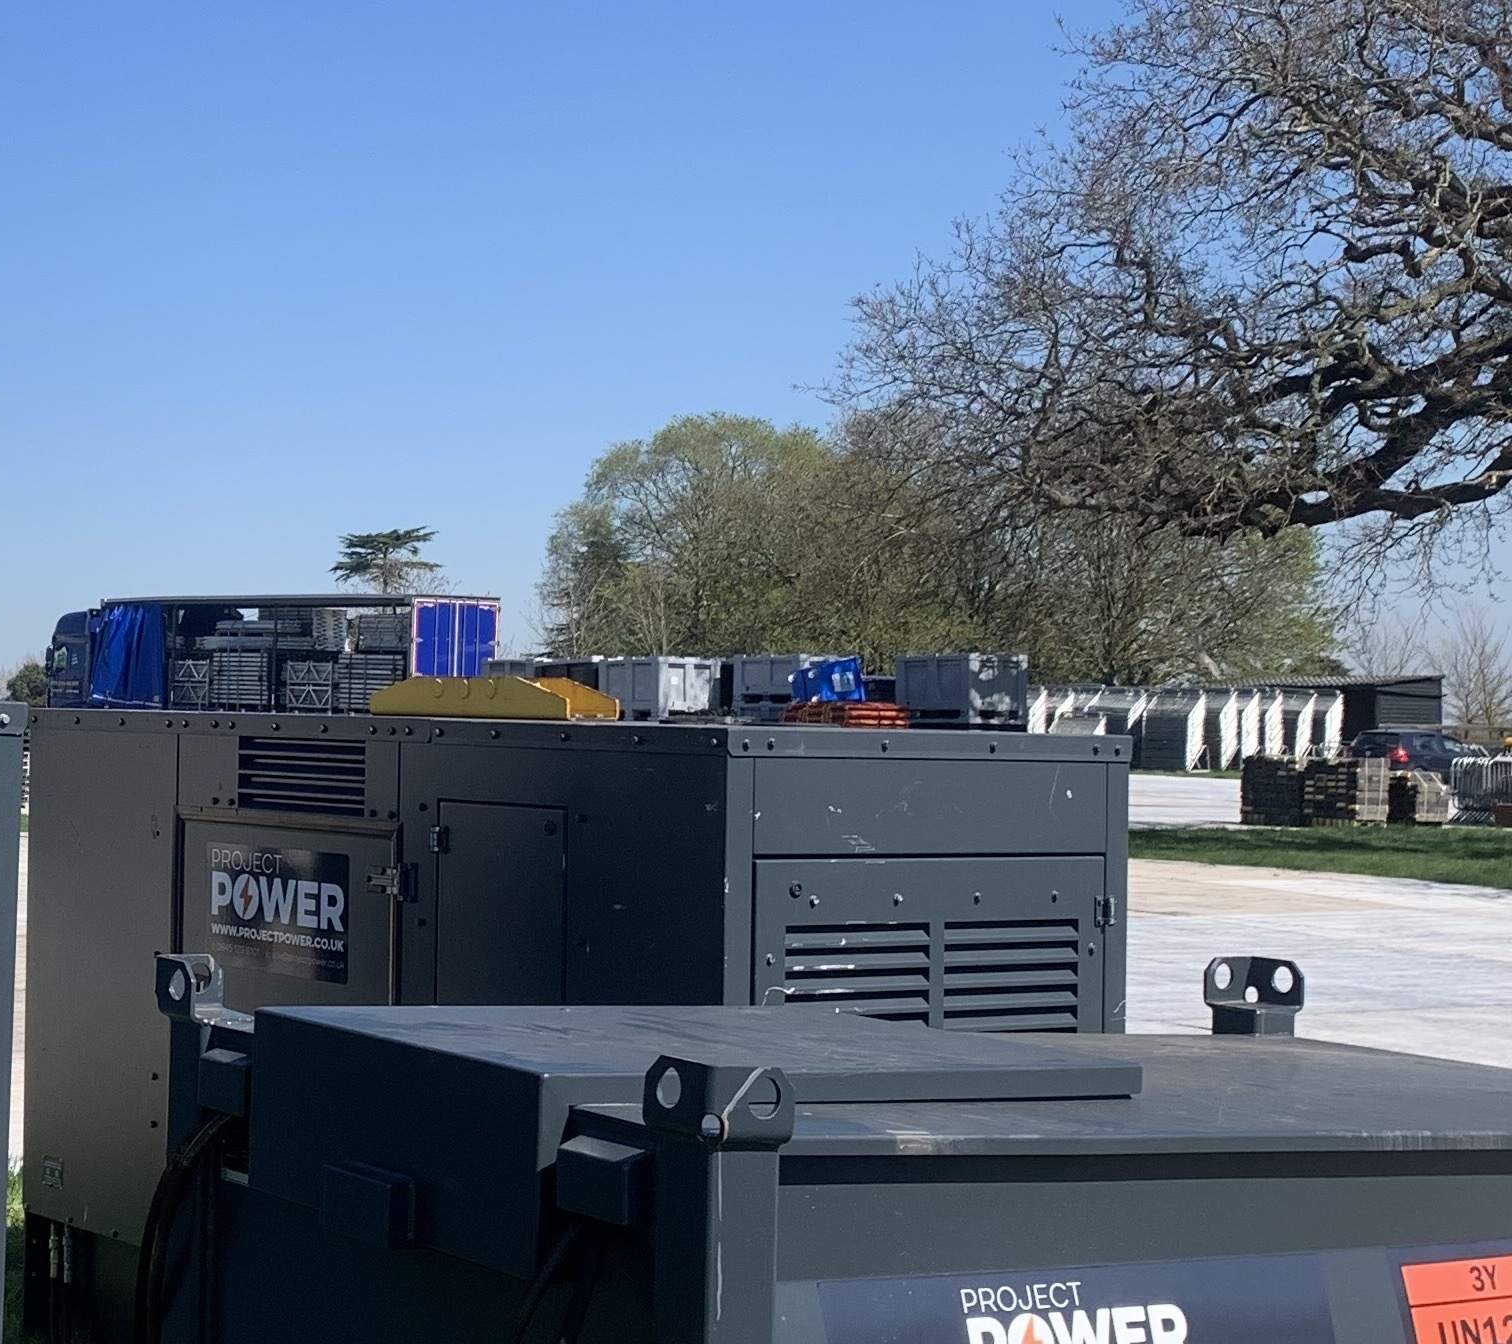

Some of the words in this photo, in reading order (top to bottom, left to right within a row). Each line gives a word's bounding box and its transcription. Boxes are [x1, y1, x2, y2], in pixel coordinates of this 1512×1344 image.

[211, 848, 282, 874] PROJECT
[211, 870, 345, 932] POWER
[211, 922, 344, 952] WWW.PROJECTPOWER.CO.UK
[1469, 1264, 1496, 1292] 3Y
[960, 1281, 1081, 1314] PROJECT
